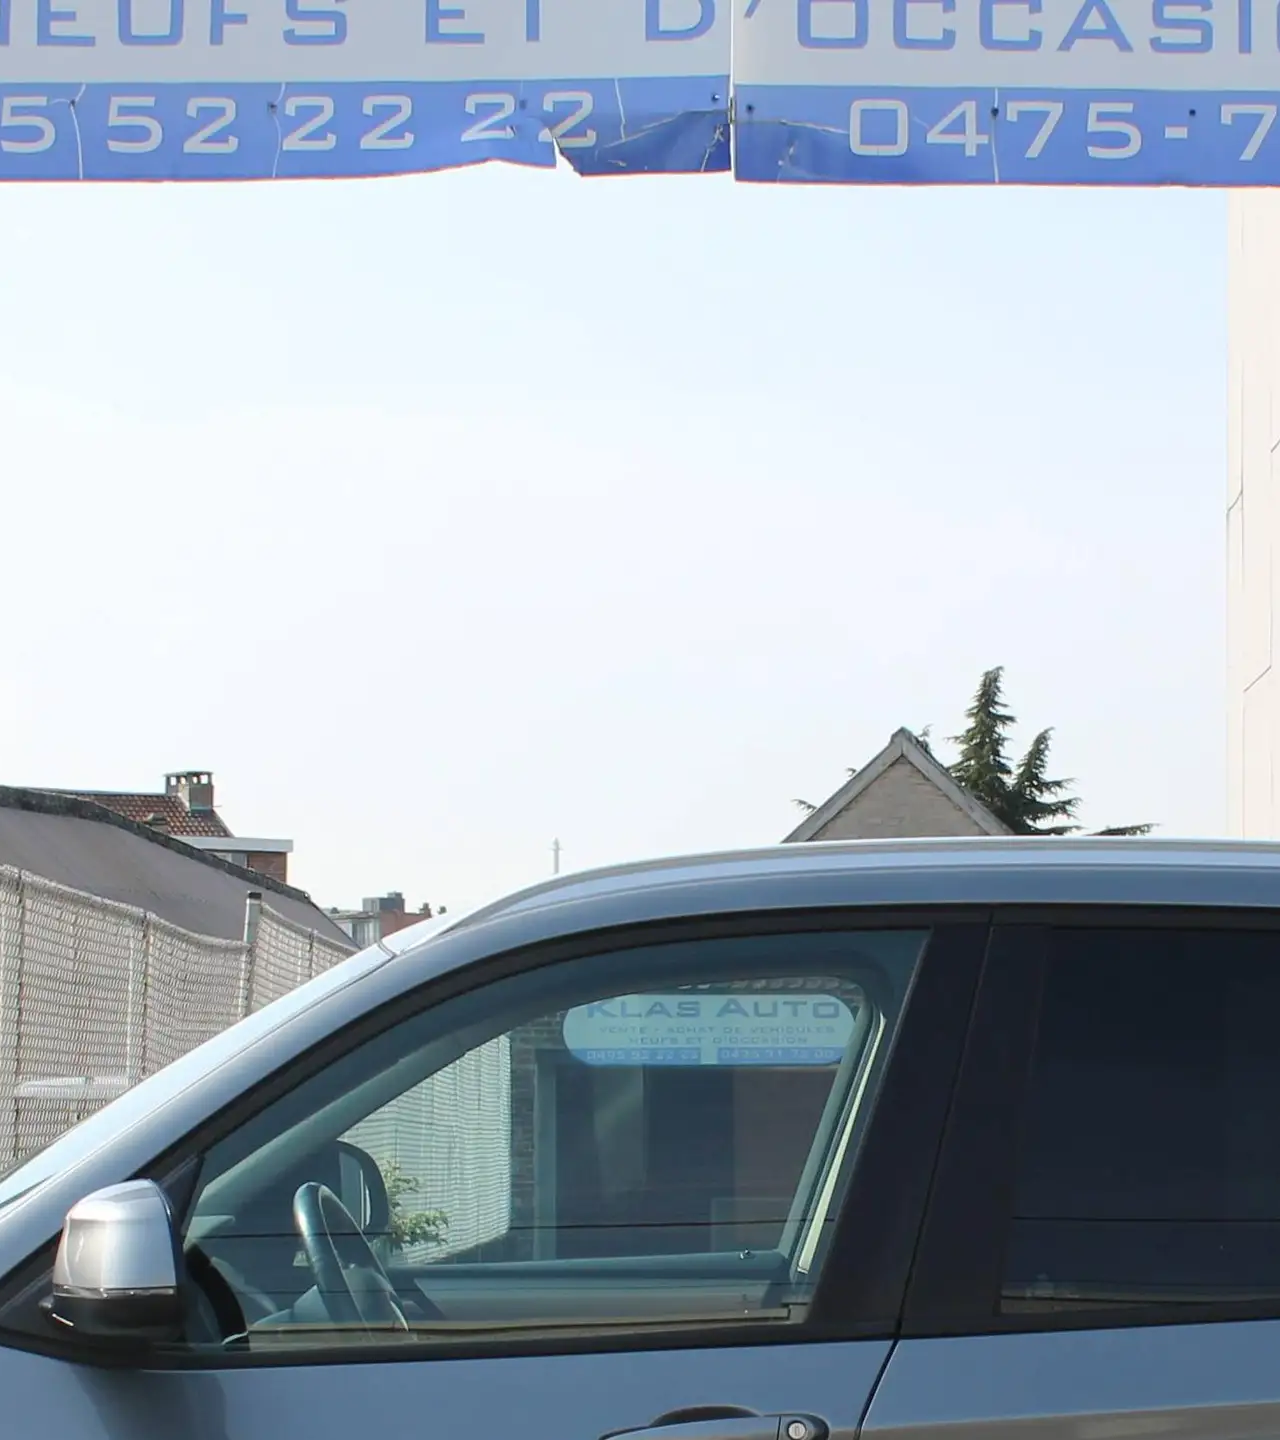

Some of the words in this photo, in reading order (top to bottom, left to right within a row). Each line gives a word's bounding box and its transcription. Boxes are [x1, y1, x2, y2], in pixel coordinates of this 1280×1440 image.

[106, 95, 239, 154] 52
[281, 94, 415, 151] 22
[460, 91, 598, 148] 22
[586, 1000, 701, 1019] KLAS
[715, 997, 840, 1019] AUTO
